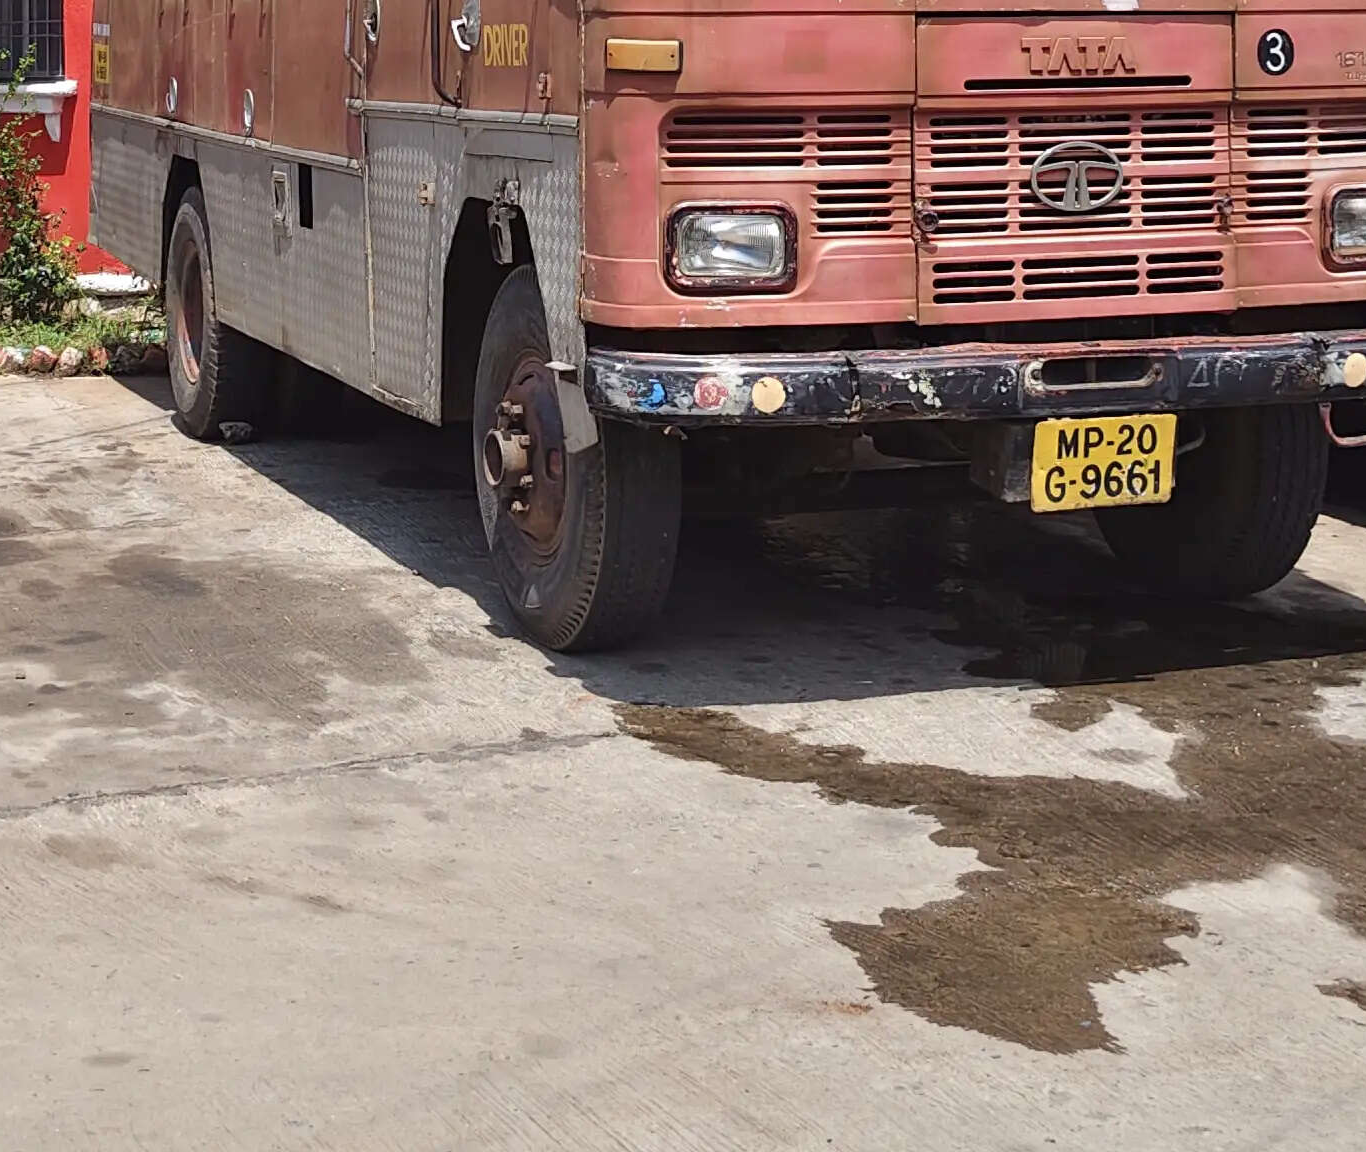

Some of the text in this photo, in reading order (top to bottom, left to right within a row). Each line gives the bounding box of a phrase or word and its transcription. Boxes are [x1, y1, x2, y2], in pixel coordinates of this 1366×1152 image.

[483, 23, 528, 67] DRIVER
[1021, 36, 1136, 75] TATA
[1266, 32, 1285, 72] 3
[1057, 424, 1157, 459] MP-20
[1045, 459, 1161, 503] G-9661
